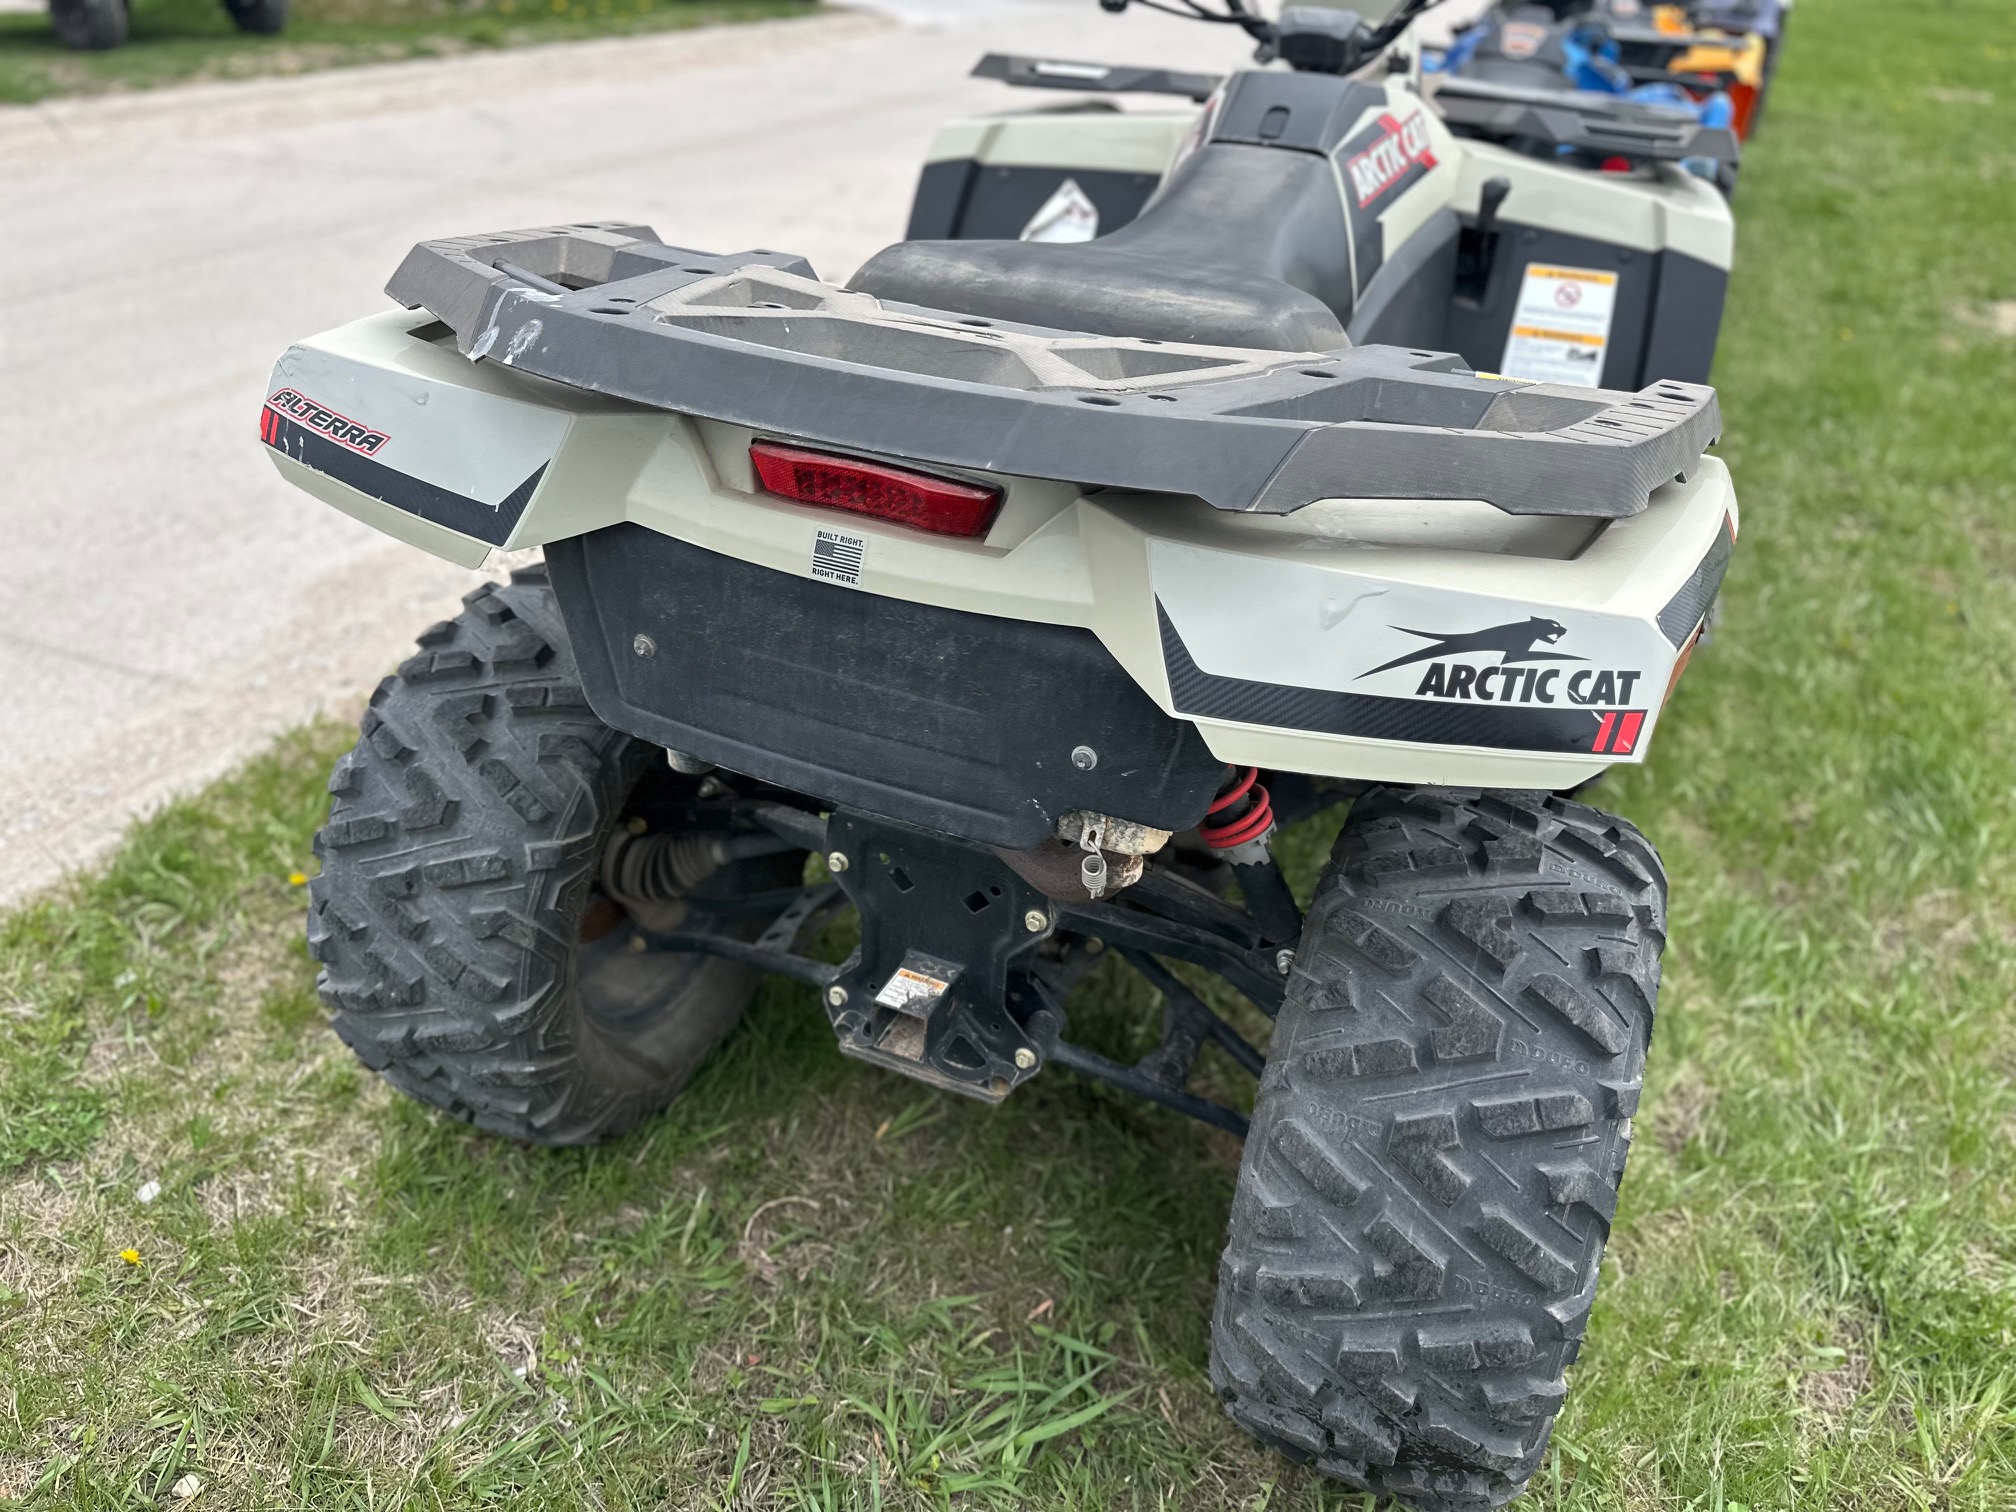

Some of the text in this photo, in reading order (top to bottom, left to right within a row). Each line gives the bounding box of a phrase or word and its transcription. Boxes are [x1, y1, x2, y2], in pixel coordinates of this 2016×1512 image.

[1351, 131, 1407, 200] ARCTIC
[272, 391, 385, 452] ALTERRA
[817, 530, 864, 548] BUILT RIGHT.
[812, 567, 859, 585] RIGHT HERE.
[1415, 662, 1642, 706] ARCTIC CAT
